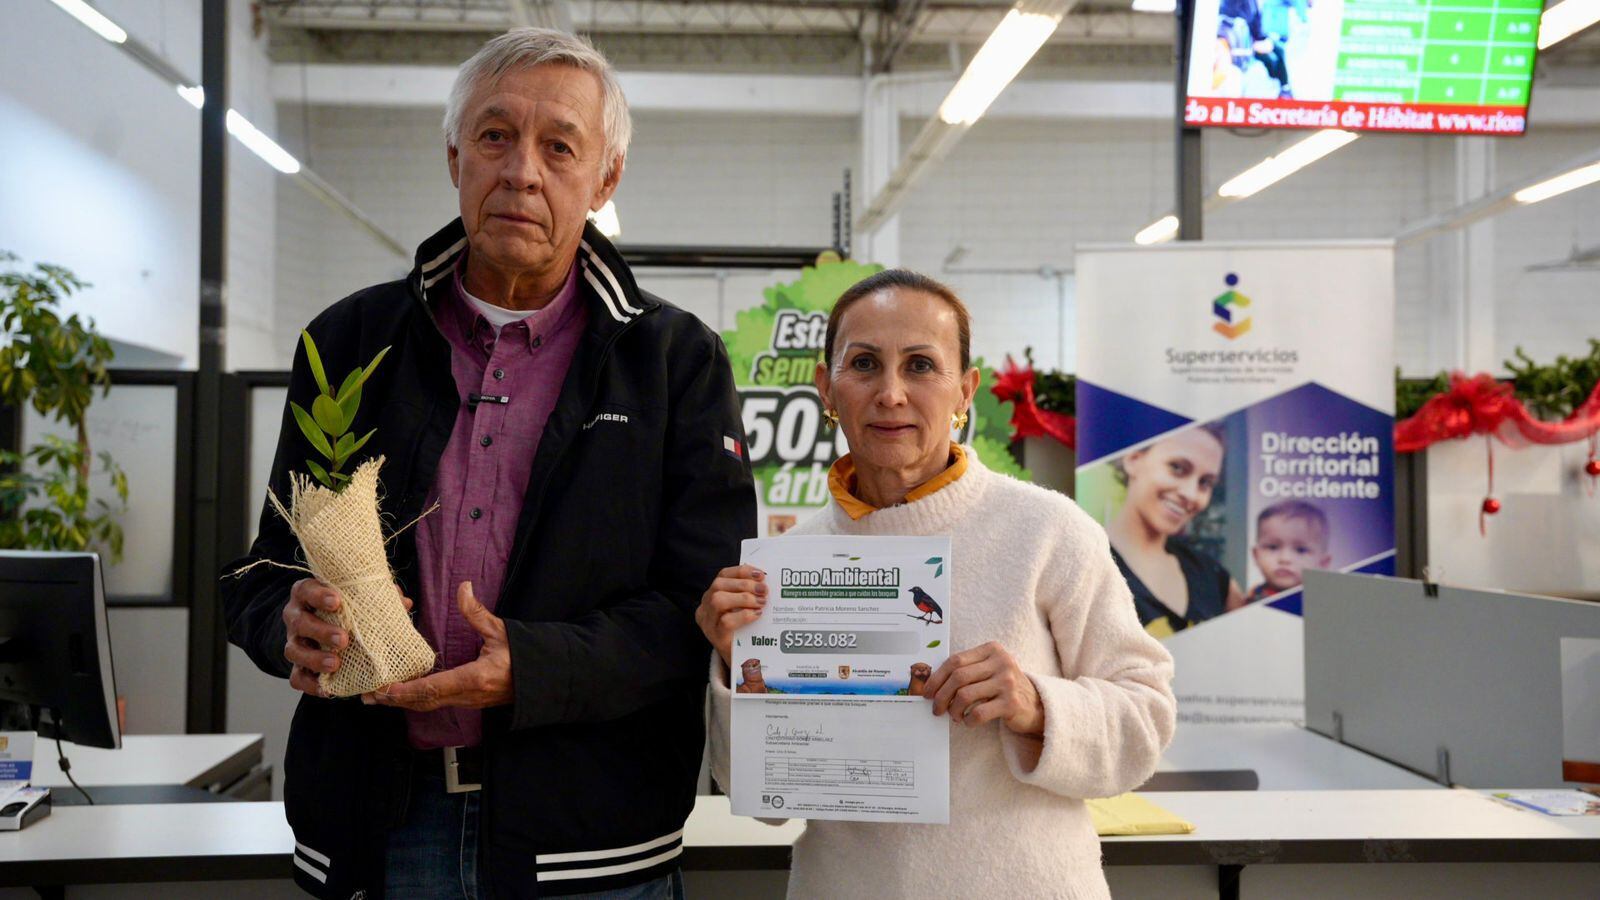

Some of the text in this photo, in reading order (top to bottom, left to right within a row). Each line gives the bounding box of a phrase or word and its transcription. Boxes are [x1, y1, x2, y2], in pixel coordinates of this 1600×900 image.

[1210, 106, 1224, 123] a
[1226, 101, 1246, 123] la
[1248, 103, 1338, 127] Secretaría
[1341, 106, 1365, 128] de
[1165, 347, 1298, 364] Superservicios
[756, 356, 817, 381] sem
[1261, 432, 1379, 454] Dirección
[1260, 454, 1379, 476] Territorial
[1260, 477, 1381, 499] Occidente
[781, 567, 900, 587] Bono Ambiental
[751, 631, 858, 649] Valor: $528.082
